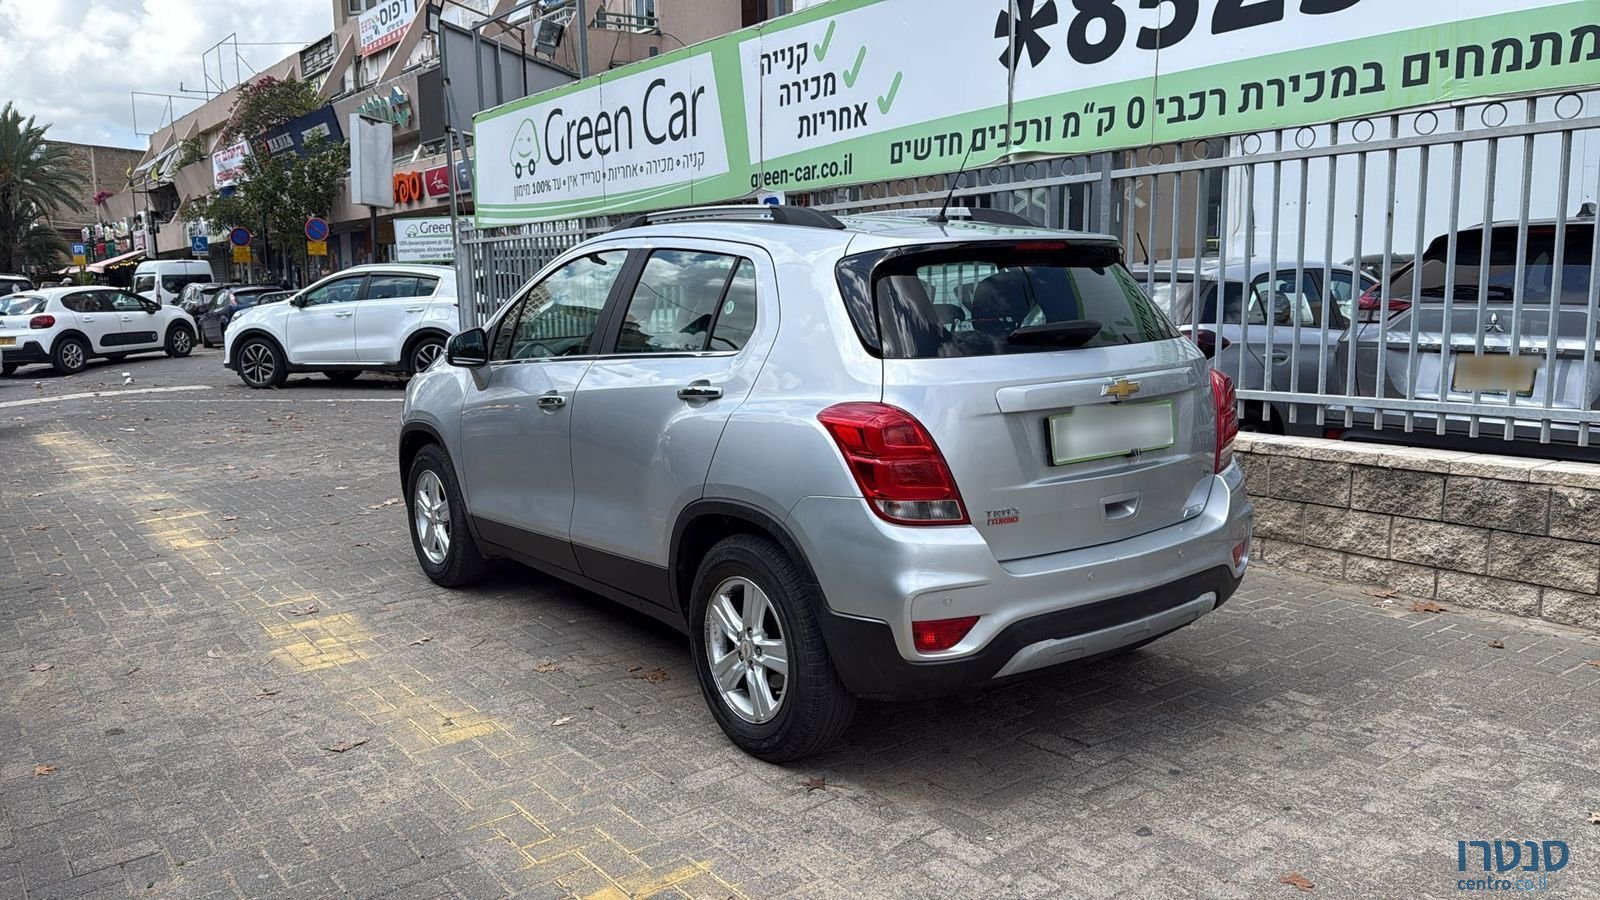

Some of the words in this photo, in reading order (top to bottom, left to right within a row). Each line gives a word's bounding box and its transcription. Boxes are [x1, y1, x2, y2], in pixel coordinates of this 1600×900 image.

[760, 42, 808, 76] קנייה
[779, 72, 837, 108] מכירה
[1238, 61, 1386, 113] במכירת
[544, 105, 633, 166] Green
[642, 78, 705, 145] Car
[797, 102, 868, 139] אחריות
[1126, 95, 1145, 129] 0
[1156, 87, 1227, 124] רכבי
[889, 131, 963, 165] חדשים
[971, 119, 1052, 152] ורכבים
[607, 163, 638, 182] אחריות
[646, 157, 674, 175] מכירה
[682, 151, 705, 172] קניה
[513, 183, 531, 201] מימון
[532, 179, 552, 194] 100%
[551, 177, 562, 191] עד
[566, 175, 578, 193] אין
[420, 222, 452, 233] Green
